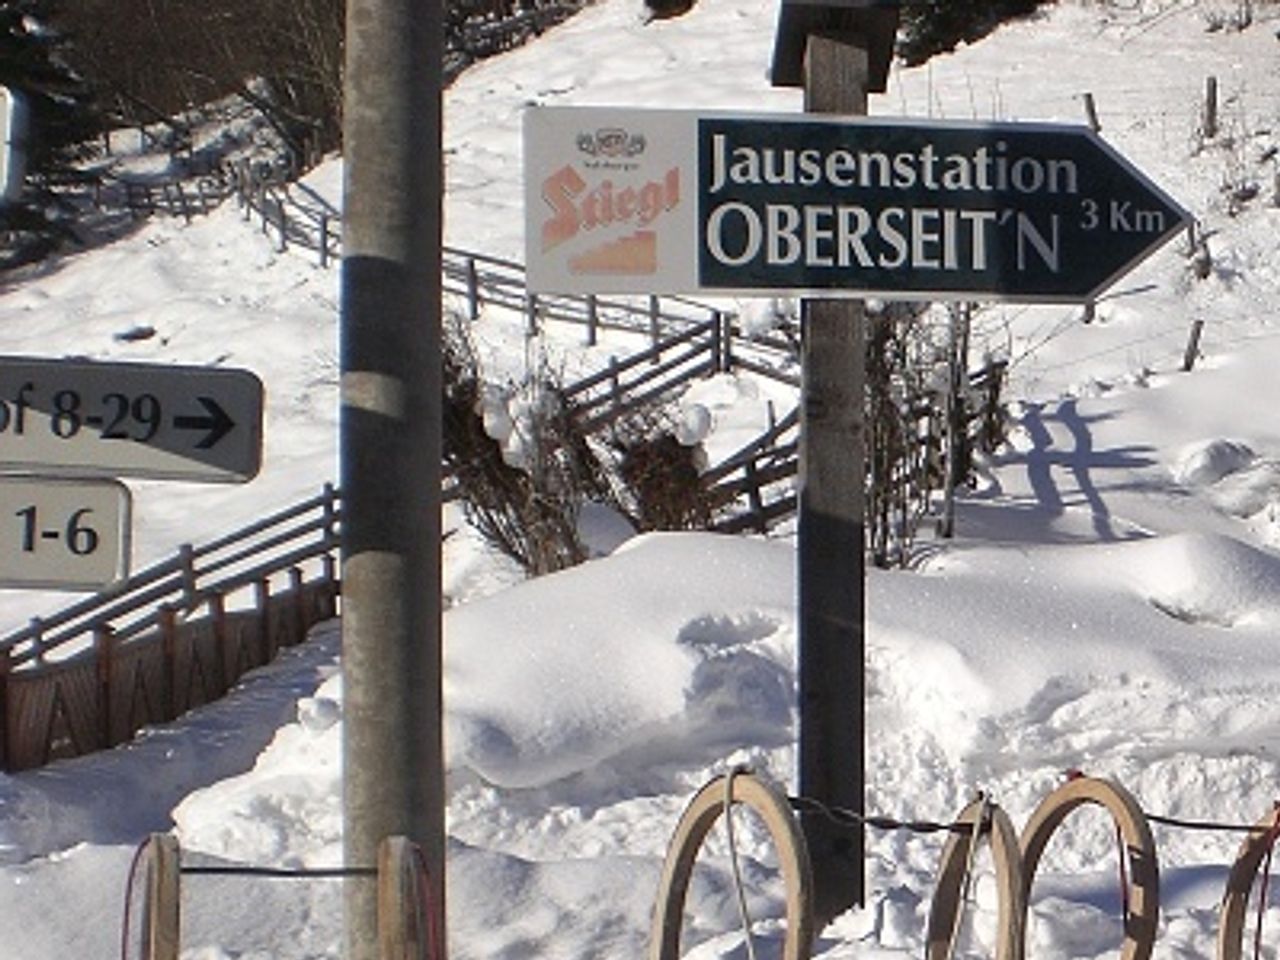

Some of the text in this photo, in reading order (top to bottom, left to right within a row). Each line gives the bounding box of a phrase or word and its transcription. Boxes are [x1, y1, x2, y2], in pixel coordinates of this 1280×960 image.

[708, 132, 1078, 195] Jausenstation
[1080, 199, 1165, 233] 3 Km
[50, 389, 162, 443] 8-29
[15, 505, 99, 556] 1-6
